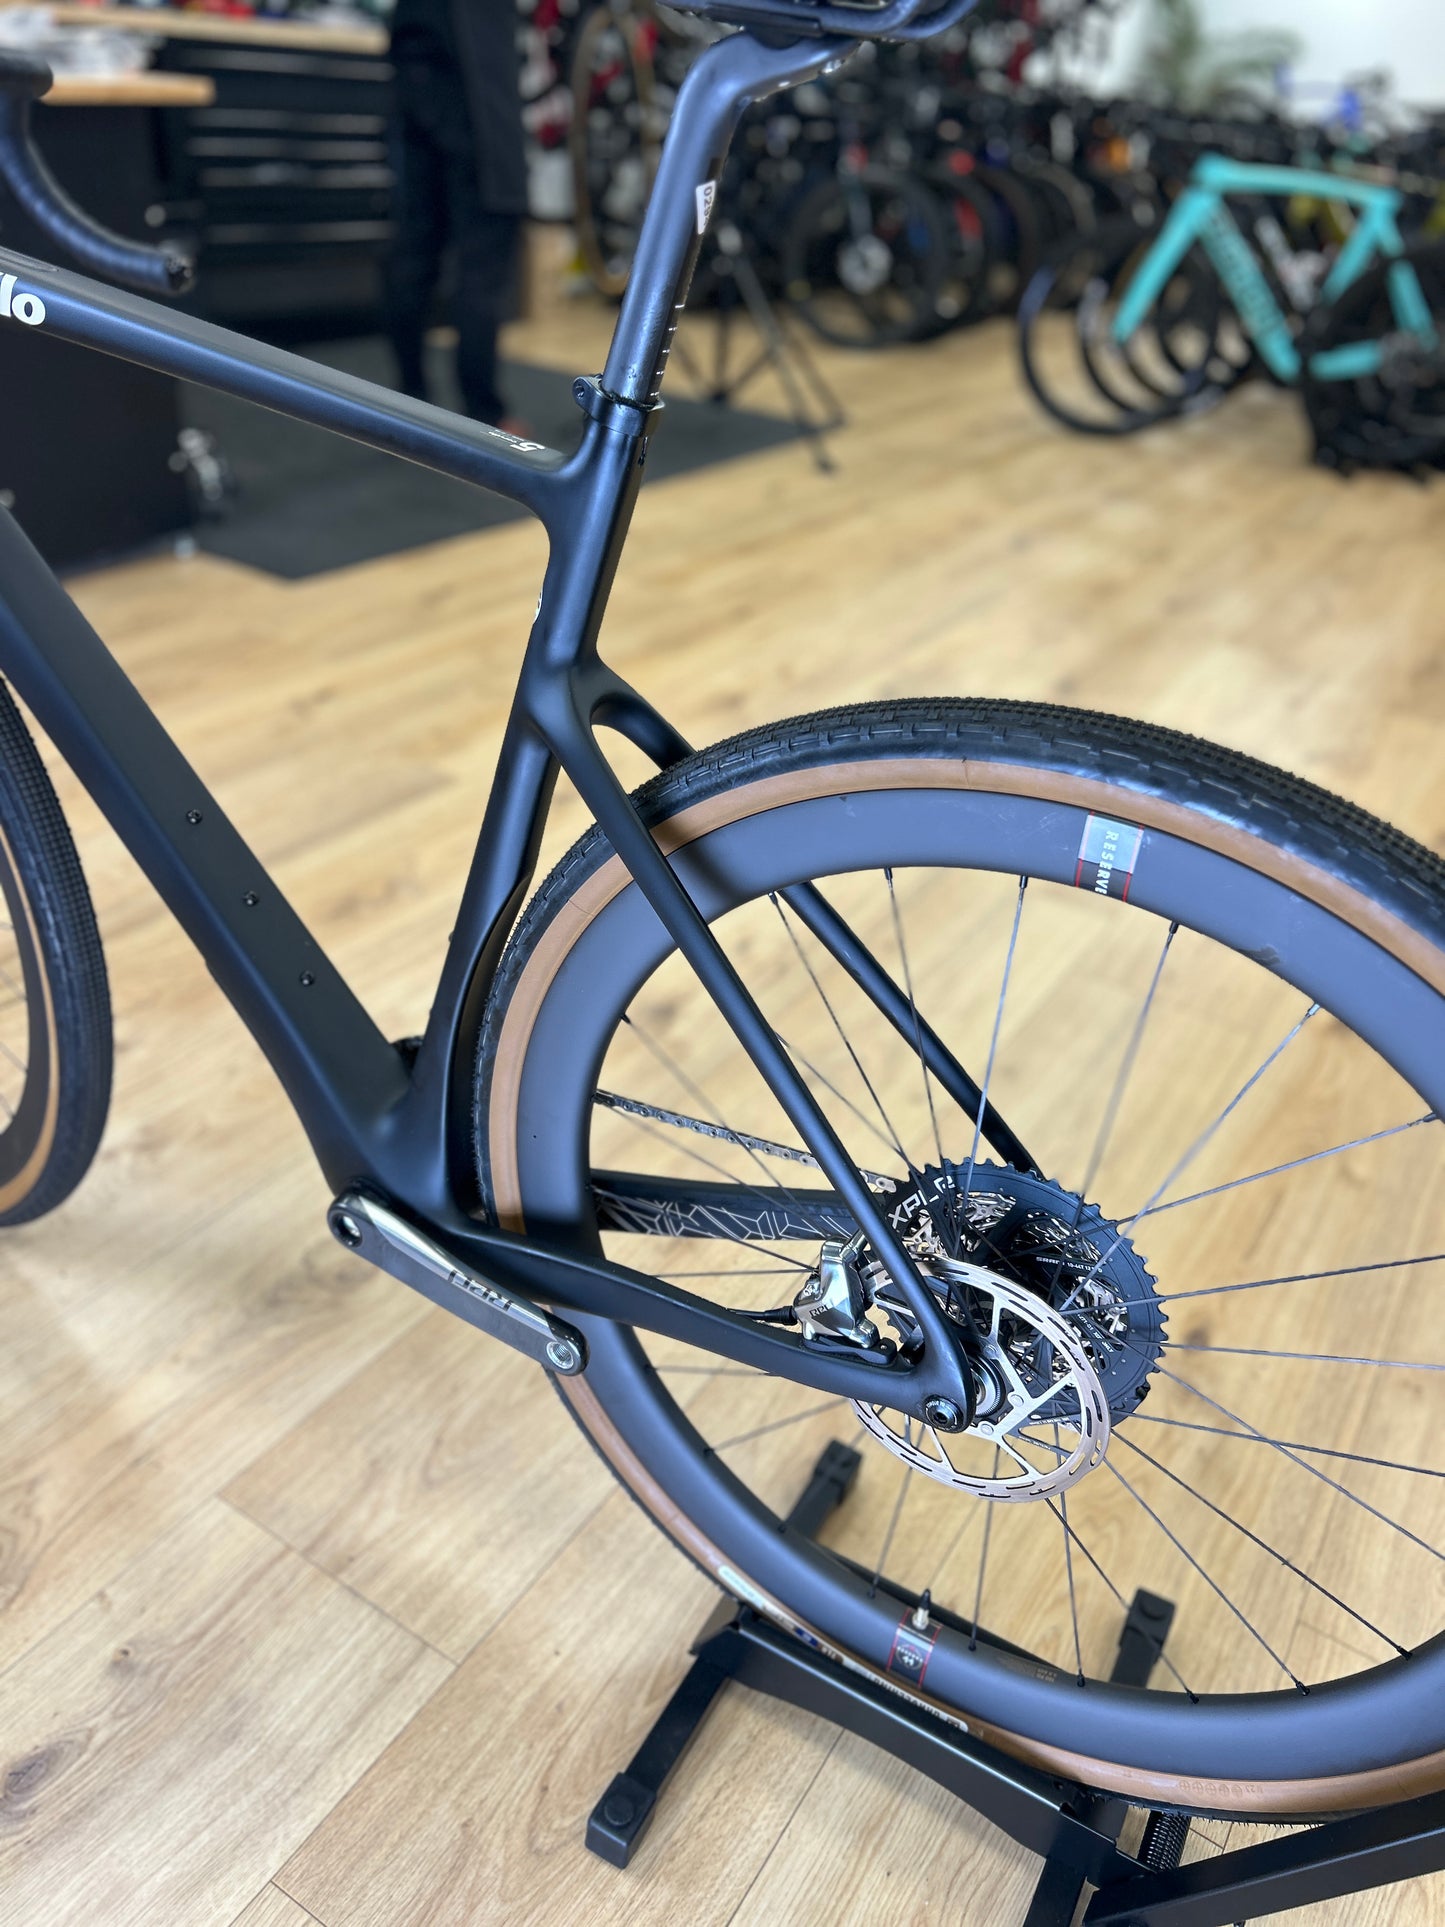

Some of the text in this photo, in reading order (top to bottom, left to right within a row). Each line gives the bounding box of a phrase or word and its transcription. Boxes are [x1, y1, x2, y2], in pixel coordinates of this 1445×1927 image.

[0, 271, 46, 326] lo
[1094, 829, 1120, 895] RESERVE
[888, 1175, 956, 1230] XPLR
